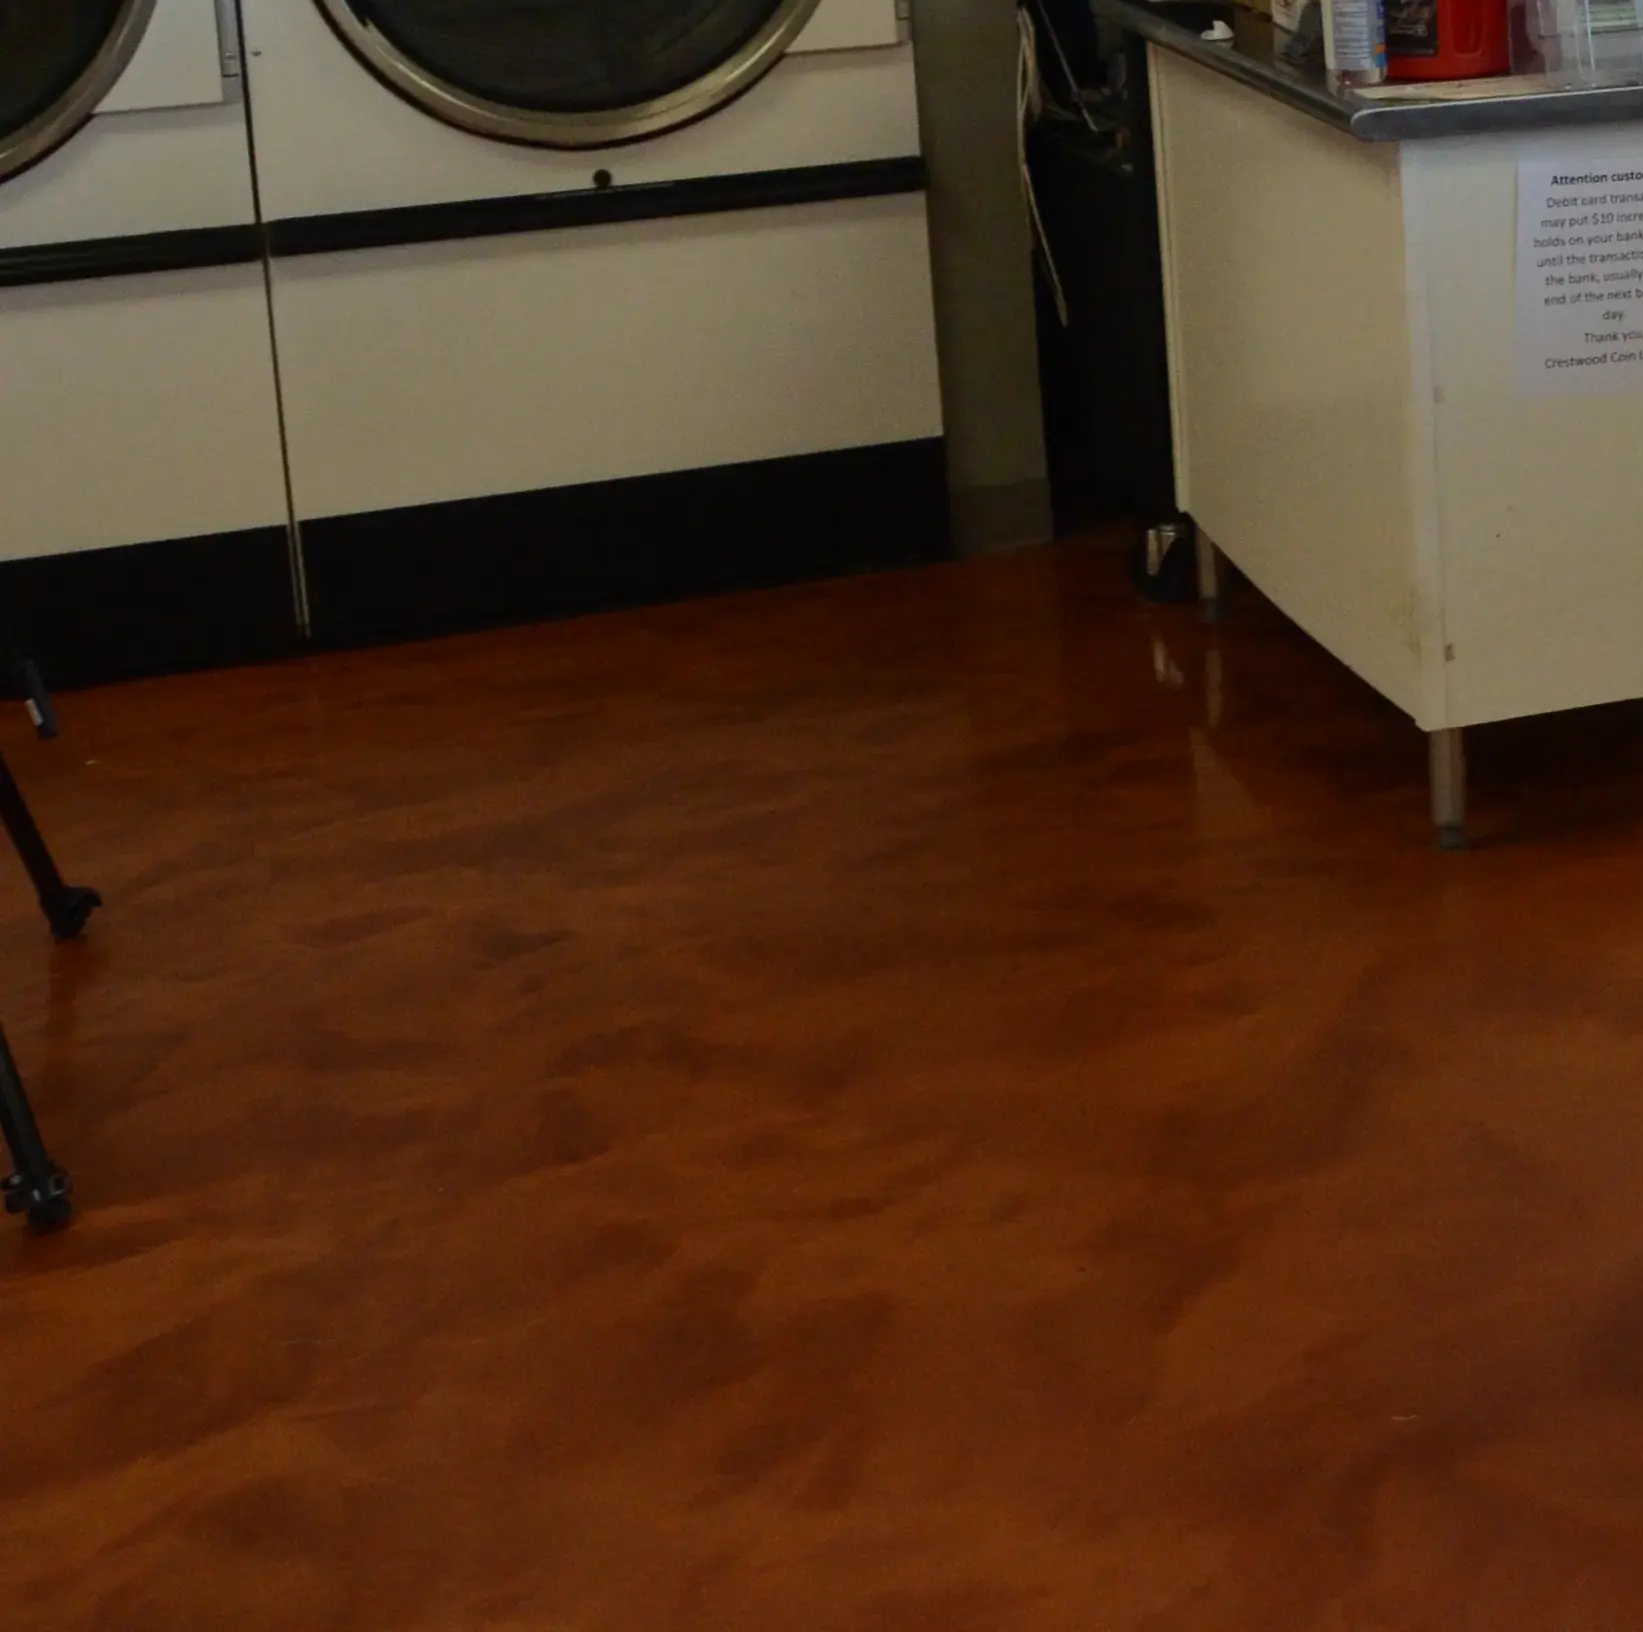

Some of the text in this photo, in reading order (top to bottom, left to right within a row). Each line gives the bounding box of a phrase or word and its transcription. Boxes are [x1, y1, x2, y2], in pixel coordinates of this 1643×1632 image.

[1551, 173, 1607, 186] Attention
[1546, 197, 1578, 209] Debit
[1582, 195, 1607, 206] card
[1616, 231, 1643, 242] bank
[1545, 354, 1607, 369] Crestwood
[1611, 351, 1636, 364] Coin
